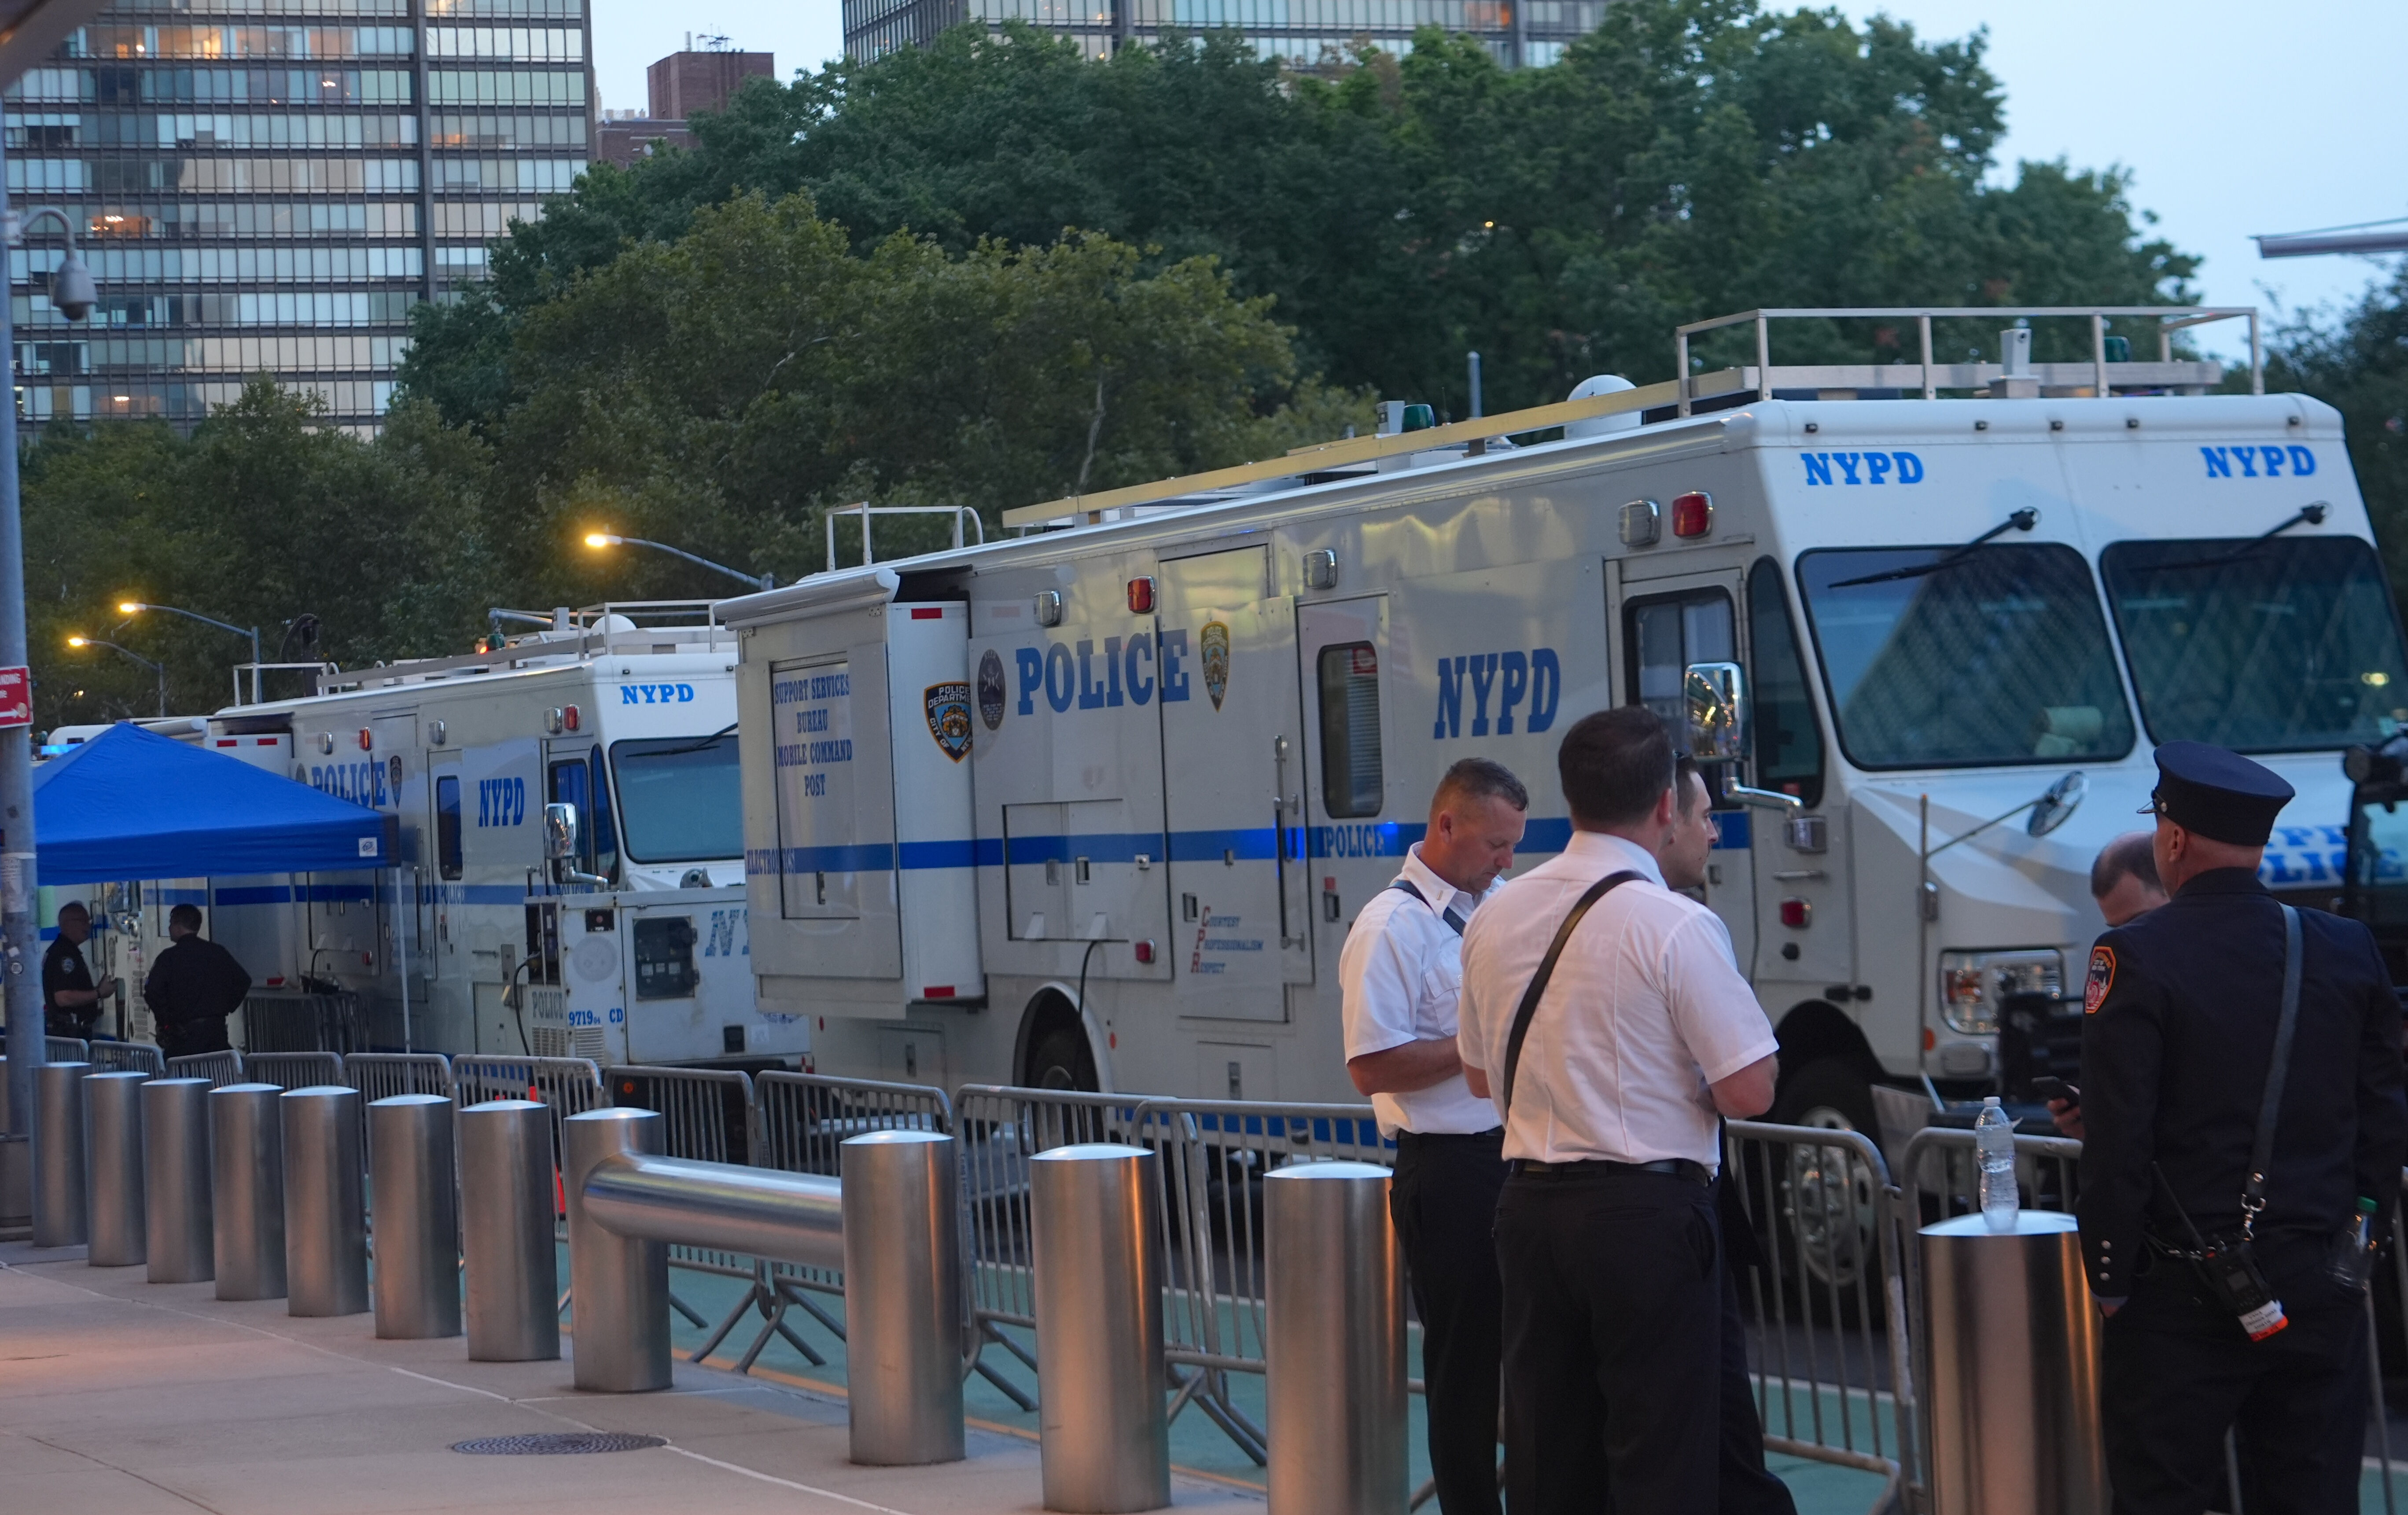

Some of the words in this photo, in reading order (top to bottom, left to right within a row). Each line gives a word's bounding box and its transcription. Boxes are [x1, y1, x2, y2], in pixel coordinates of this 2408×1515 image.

[1800, 451, 1924, 486] NYPD
[2201, 445, 2316, 477] NYPD
[1016, 629, 1189, 715] POLICE
[620, 684, 694, 704] NYPD
[775, 679, 808, 704] SUPPORT
[811, 674, 849, 700] SERVICES
[1434, 648, 1561, 739] NYPD
[797, 709, 828, 733] BUREAU
[929, 717, 941, 736] CITY
[940, 738, 950, 748] OF
[777, 743, 807, 768] MOBILE
[810, 739, 852, 764] COMMAND
[804, 773, 825, 796] POST
[478, 777, 525, 827] NYPD
[1325, 825, 1385, 857] POLICE
[532, 991, 563, 1019] POLICE
[609, 1008, 623, 1023] CD
